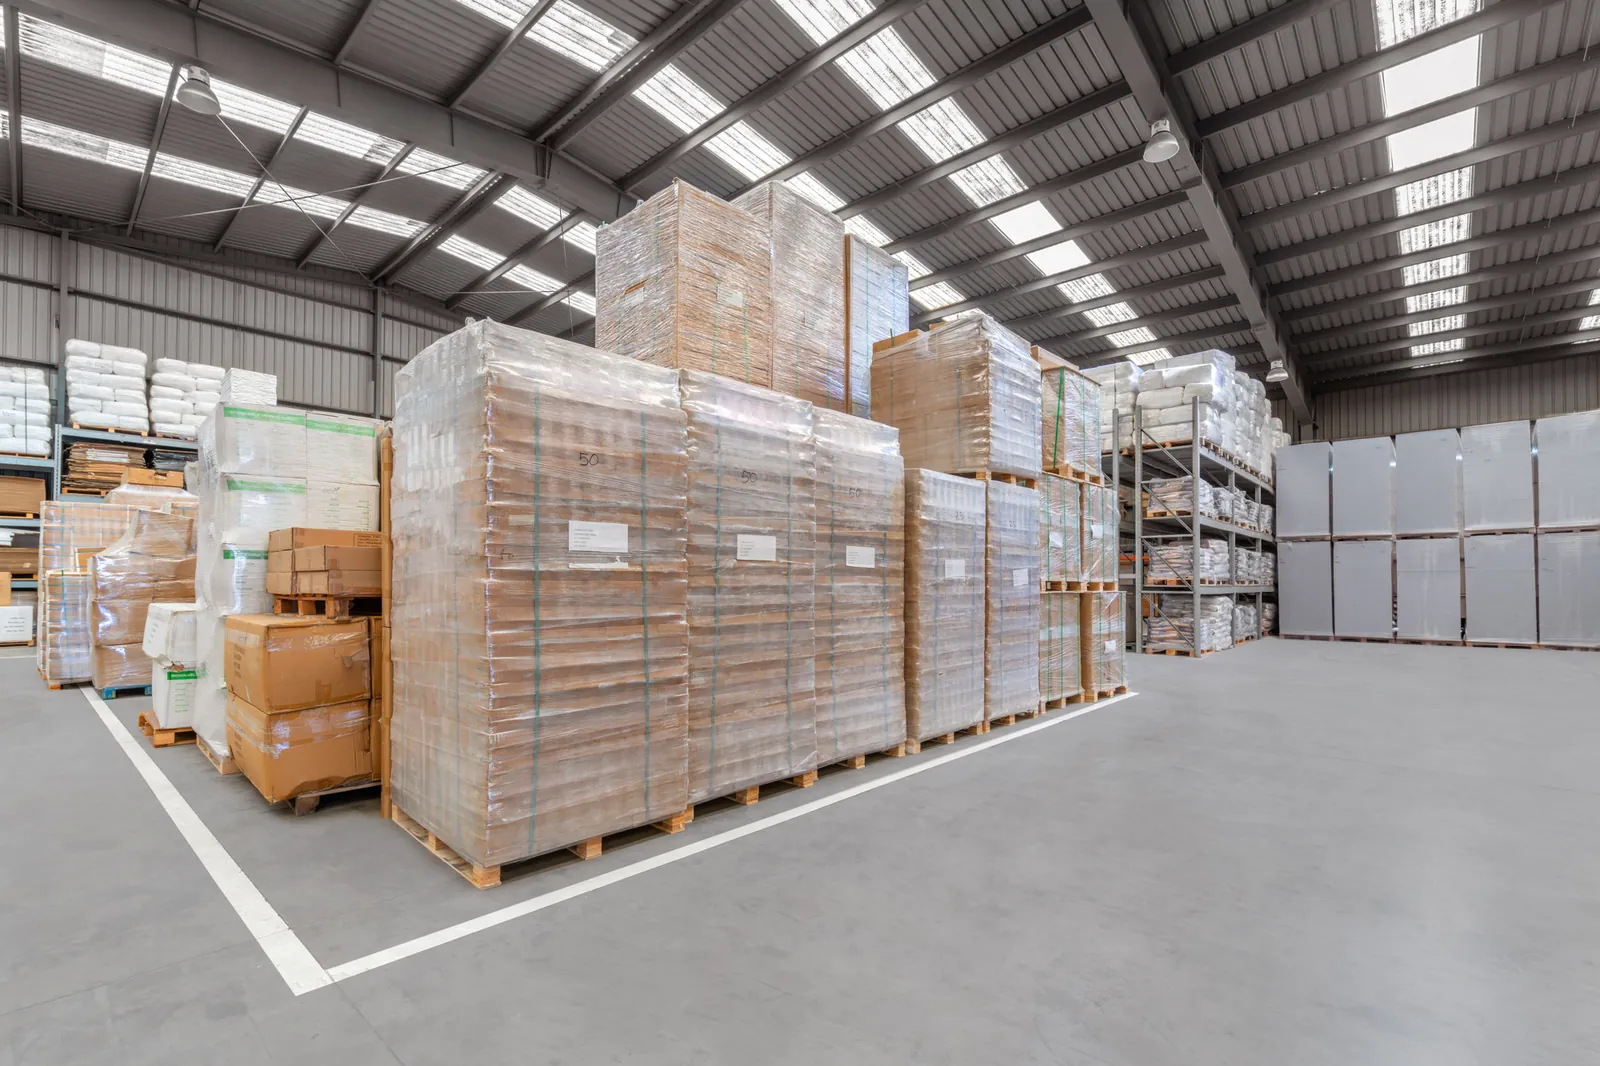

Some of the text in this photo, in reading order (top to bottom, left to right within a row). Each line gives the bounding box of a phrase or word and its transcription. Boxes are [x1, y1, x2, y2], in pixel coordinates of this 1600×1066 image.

[579, 452, 599, 466] 50
[741, 470, 758, 484] 50
[848, 487, 862, 499] 50
